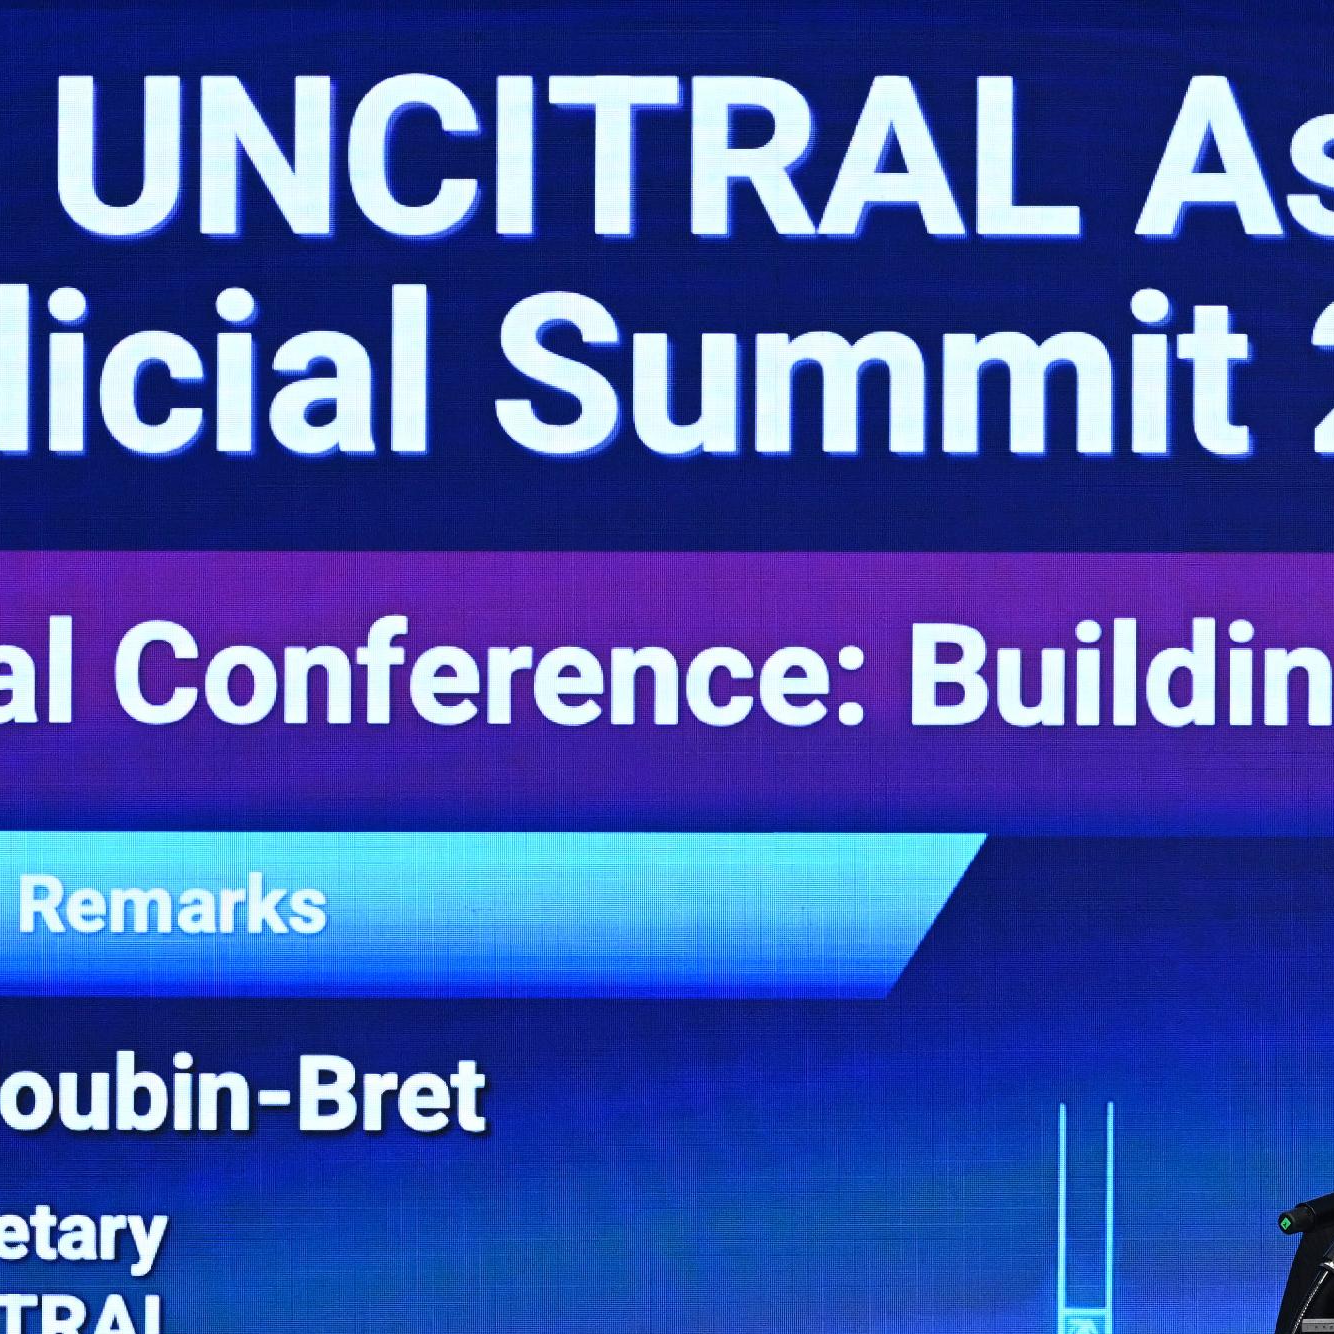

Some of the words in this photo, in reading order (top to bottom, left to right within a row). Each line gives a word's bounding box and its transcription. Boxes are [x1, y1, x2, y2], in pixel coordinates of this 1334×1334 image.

[58, 74, 1079, 235] UNCITRAL
[497, 290, 1247, 454] Summit
[116, 616, 863, 725] Conference:
[20, 872, 325, 932] Remarks
